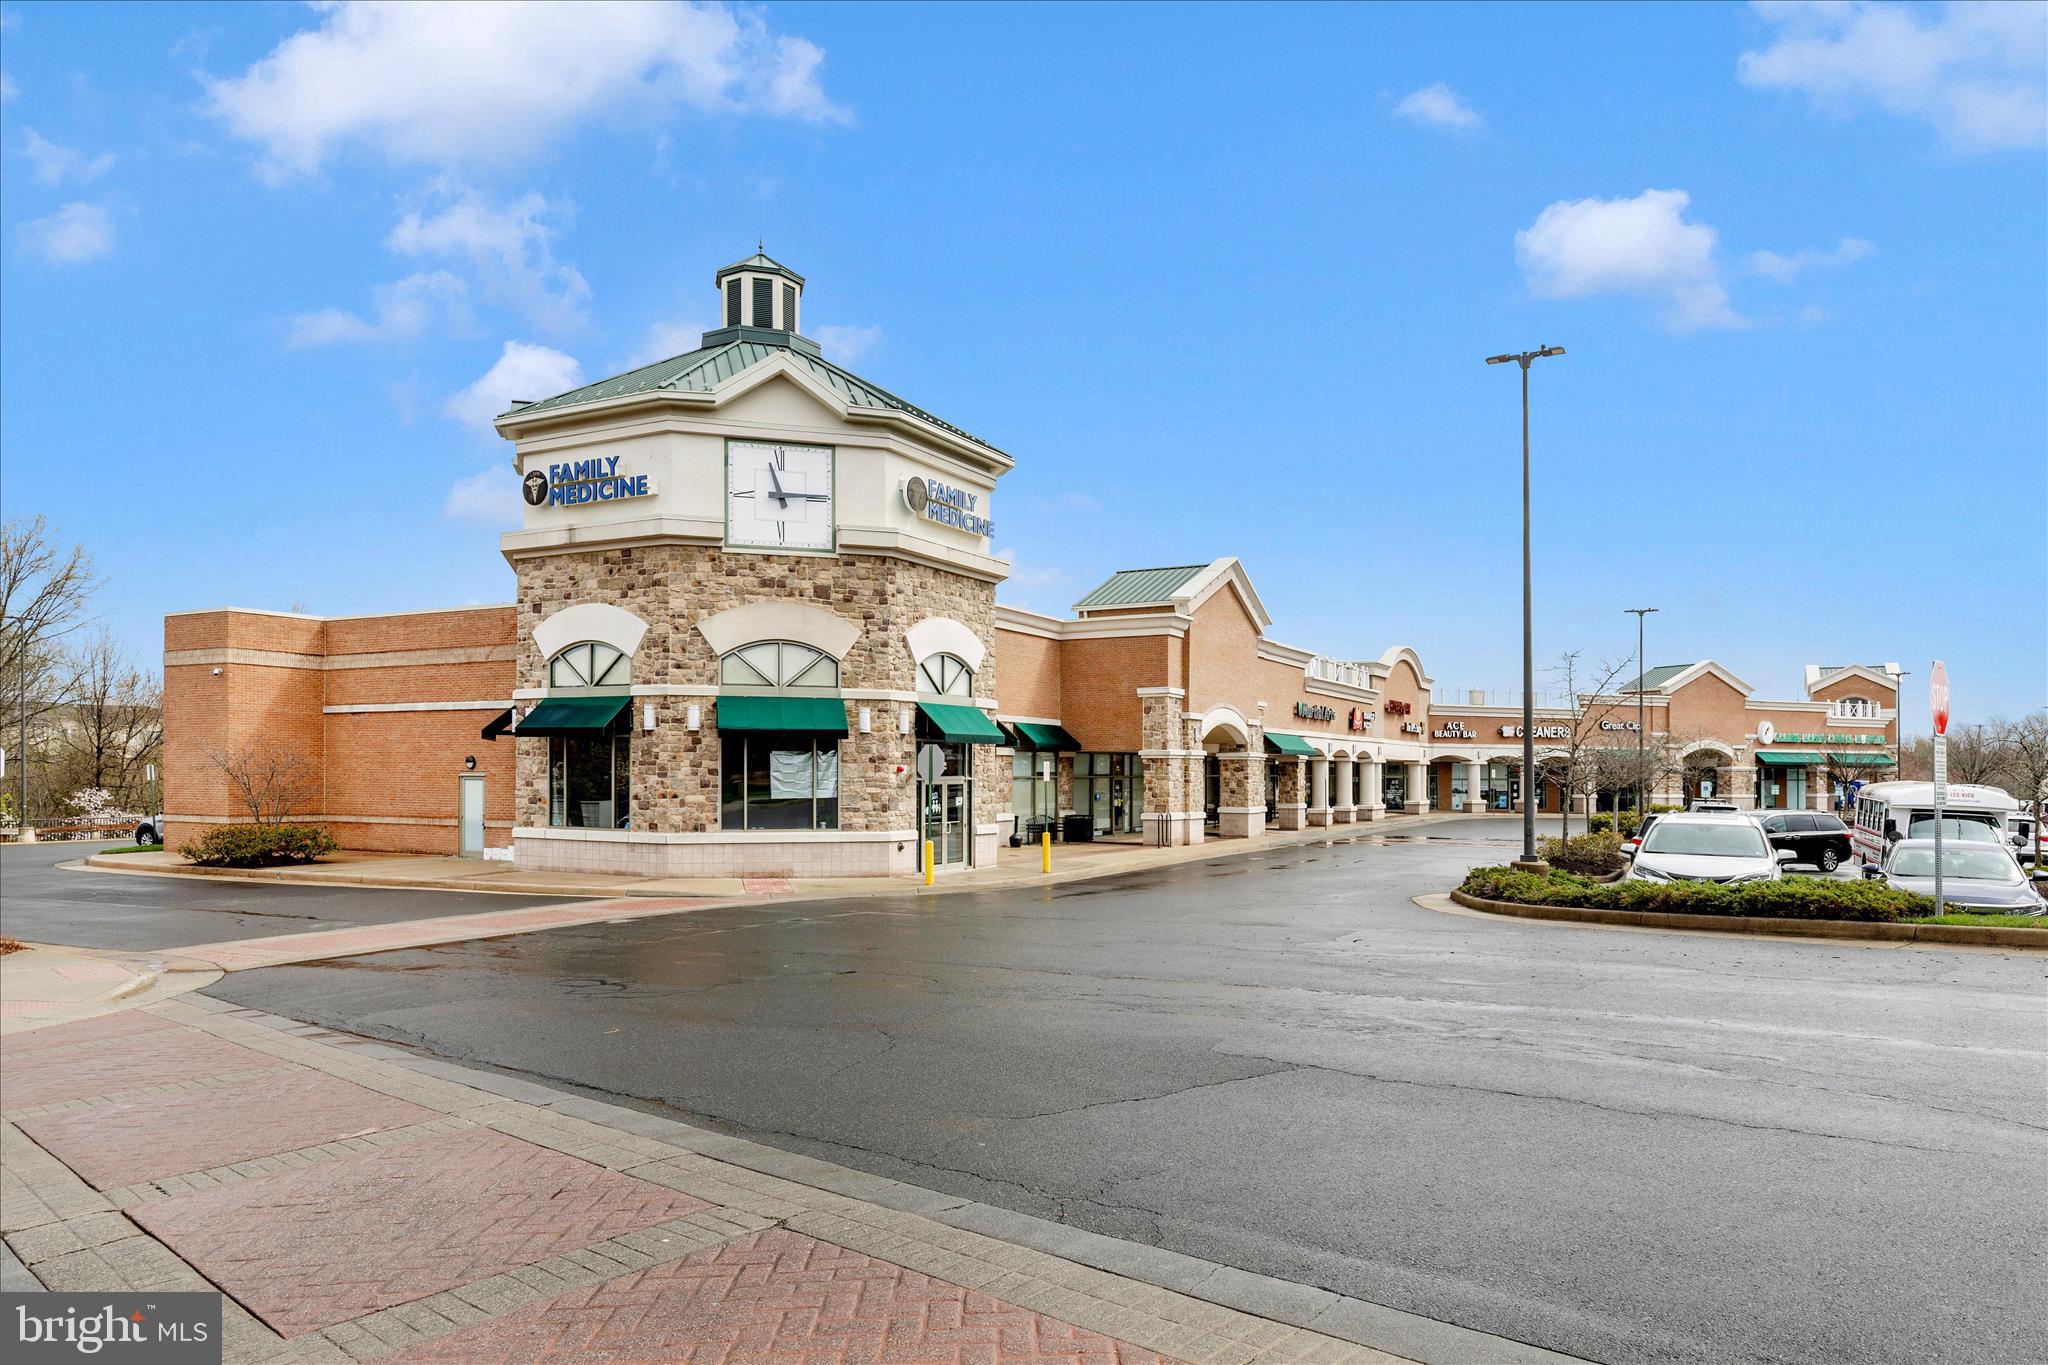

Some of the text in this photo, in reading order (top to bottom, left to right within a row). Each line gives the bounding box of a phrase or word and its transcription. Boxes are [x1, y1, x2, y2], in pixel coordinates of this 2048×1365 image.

[549, 455, 620, 484] FAMILY
[549, 475, 648, 507] MEDICINE
[928, 478, 978, 512] FAMILY
[928, 501, 995, 539] MEDICINE
[1932, 684, 1949, 712] STOP
[1434, 730, 1477, 738] BEAUTY BAR
[1446, 721, 1465, 730] ACE
[1515, 726, 1571, 738] CEANERS
[1601, 720, 1642, 731] Great Clip
